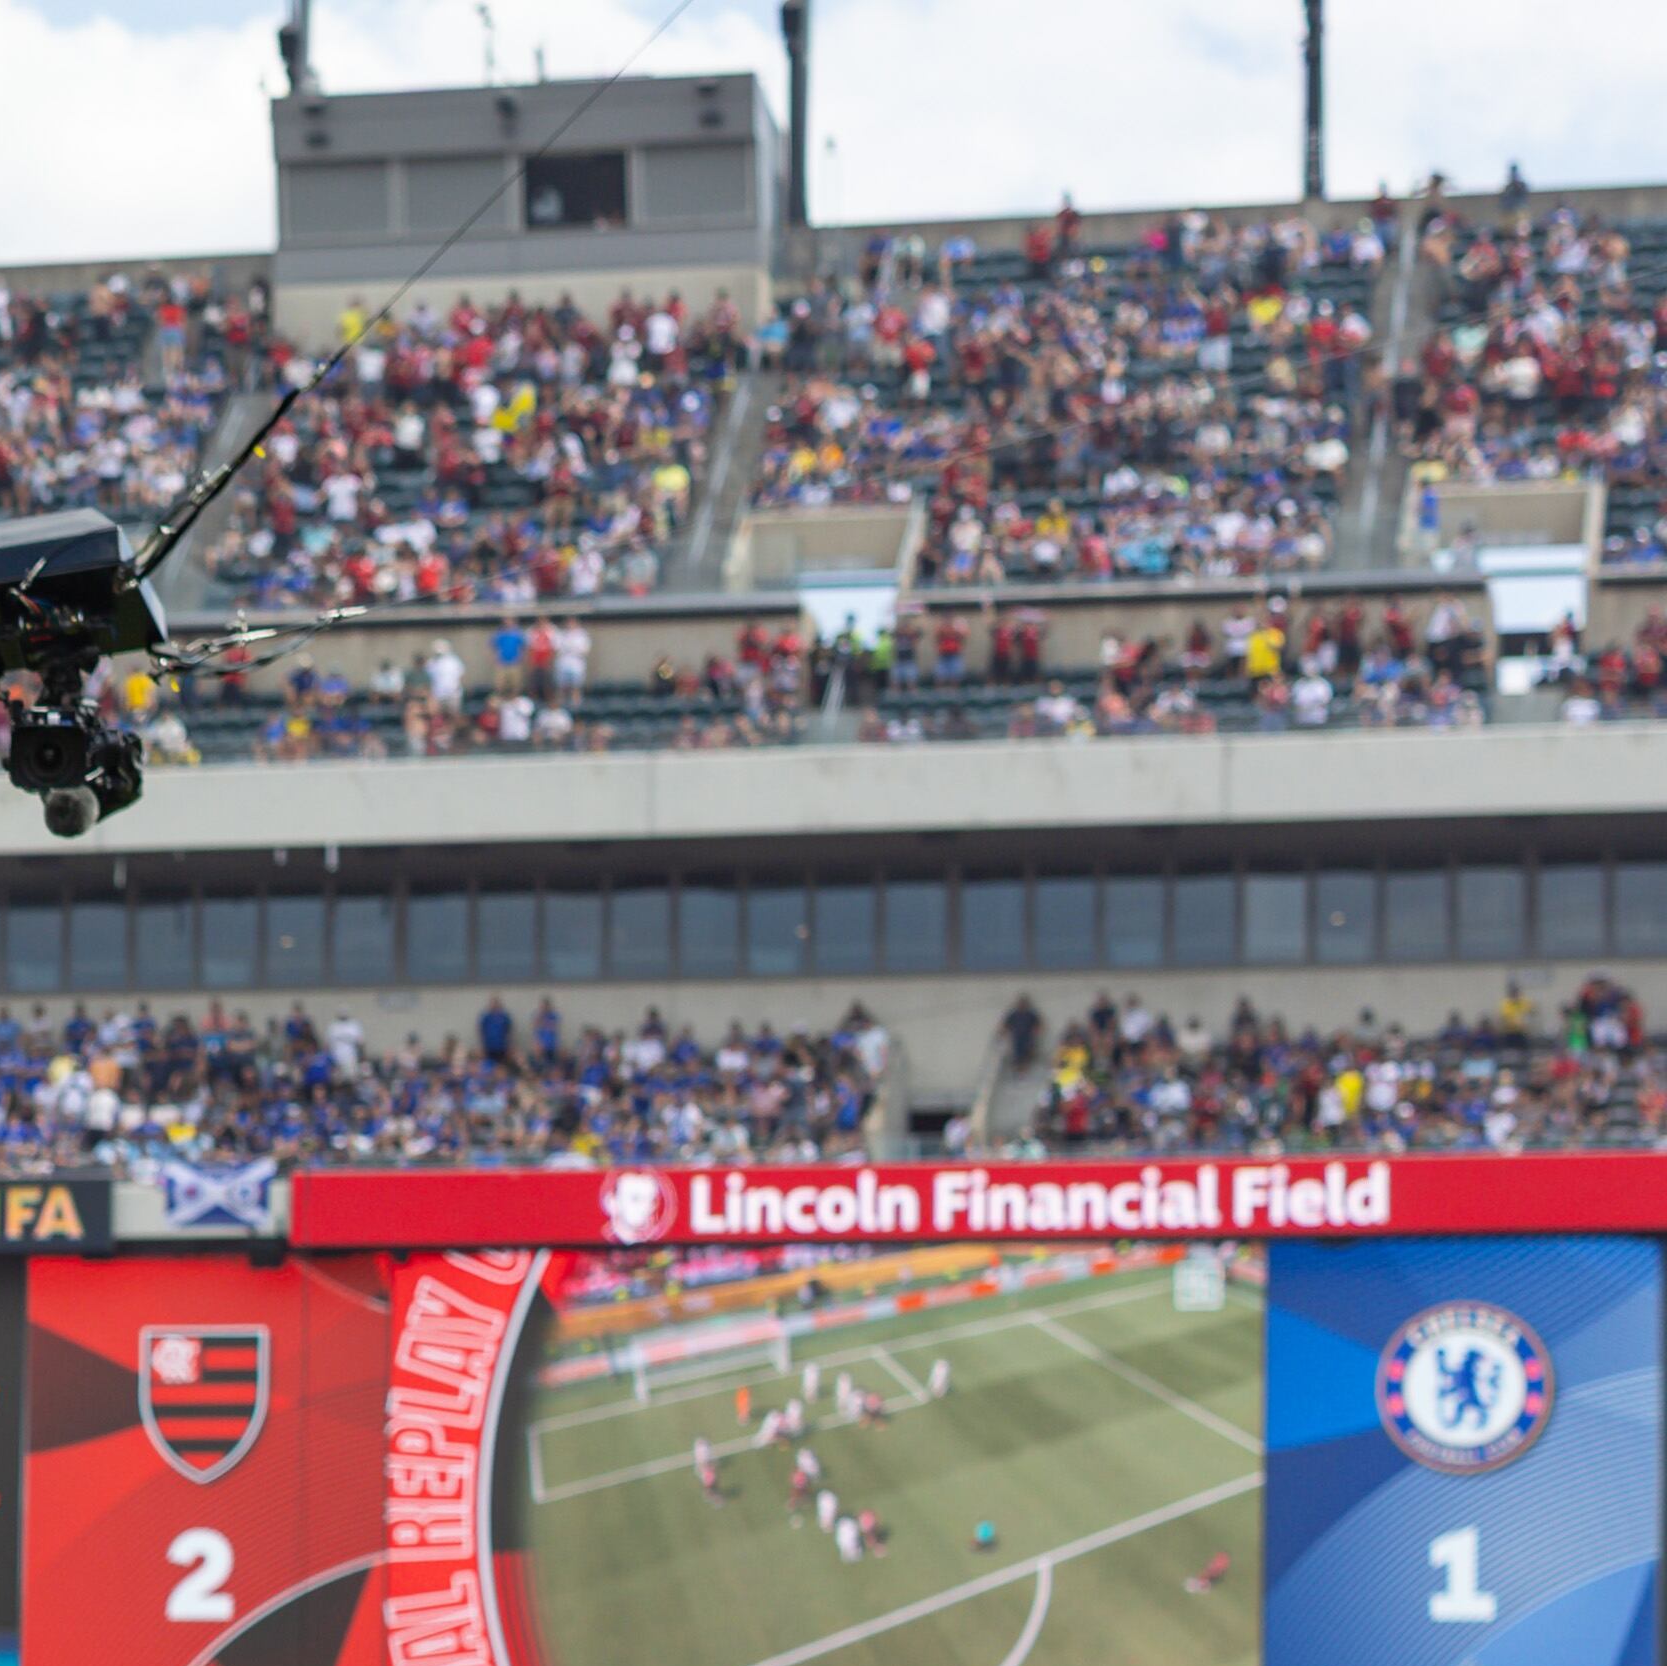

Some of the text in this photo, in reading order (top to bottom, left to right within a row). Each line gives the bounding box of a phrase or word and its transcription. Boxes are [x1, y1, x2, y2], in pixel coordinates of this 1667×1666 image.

[690, 1163, 1391, 1236] Lincoln Financial Field
[164, 1526, 237, 1624] 2
[1425, 1526, 1499, 1623] 1
